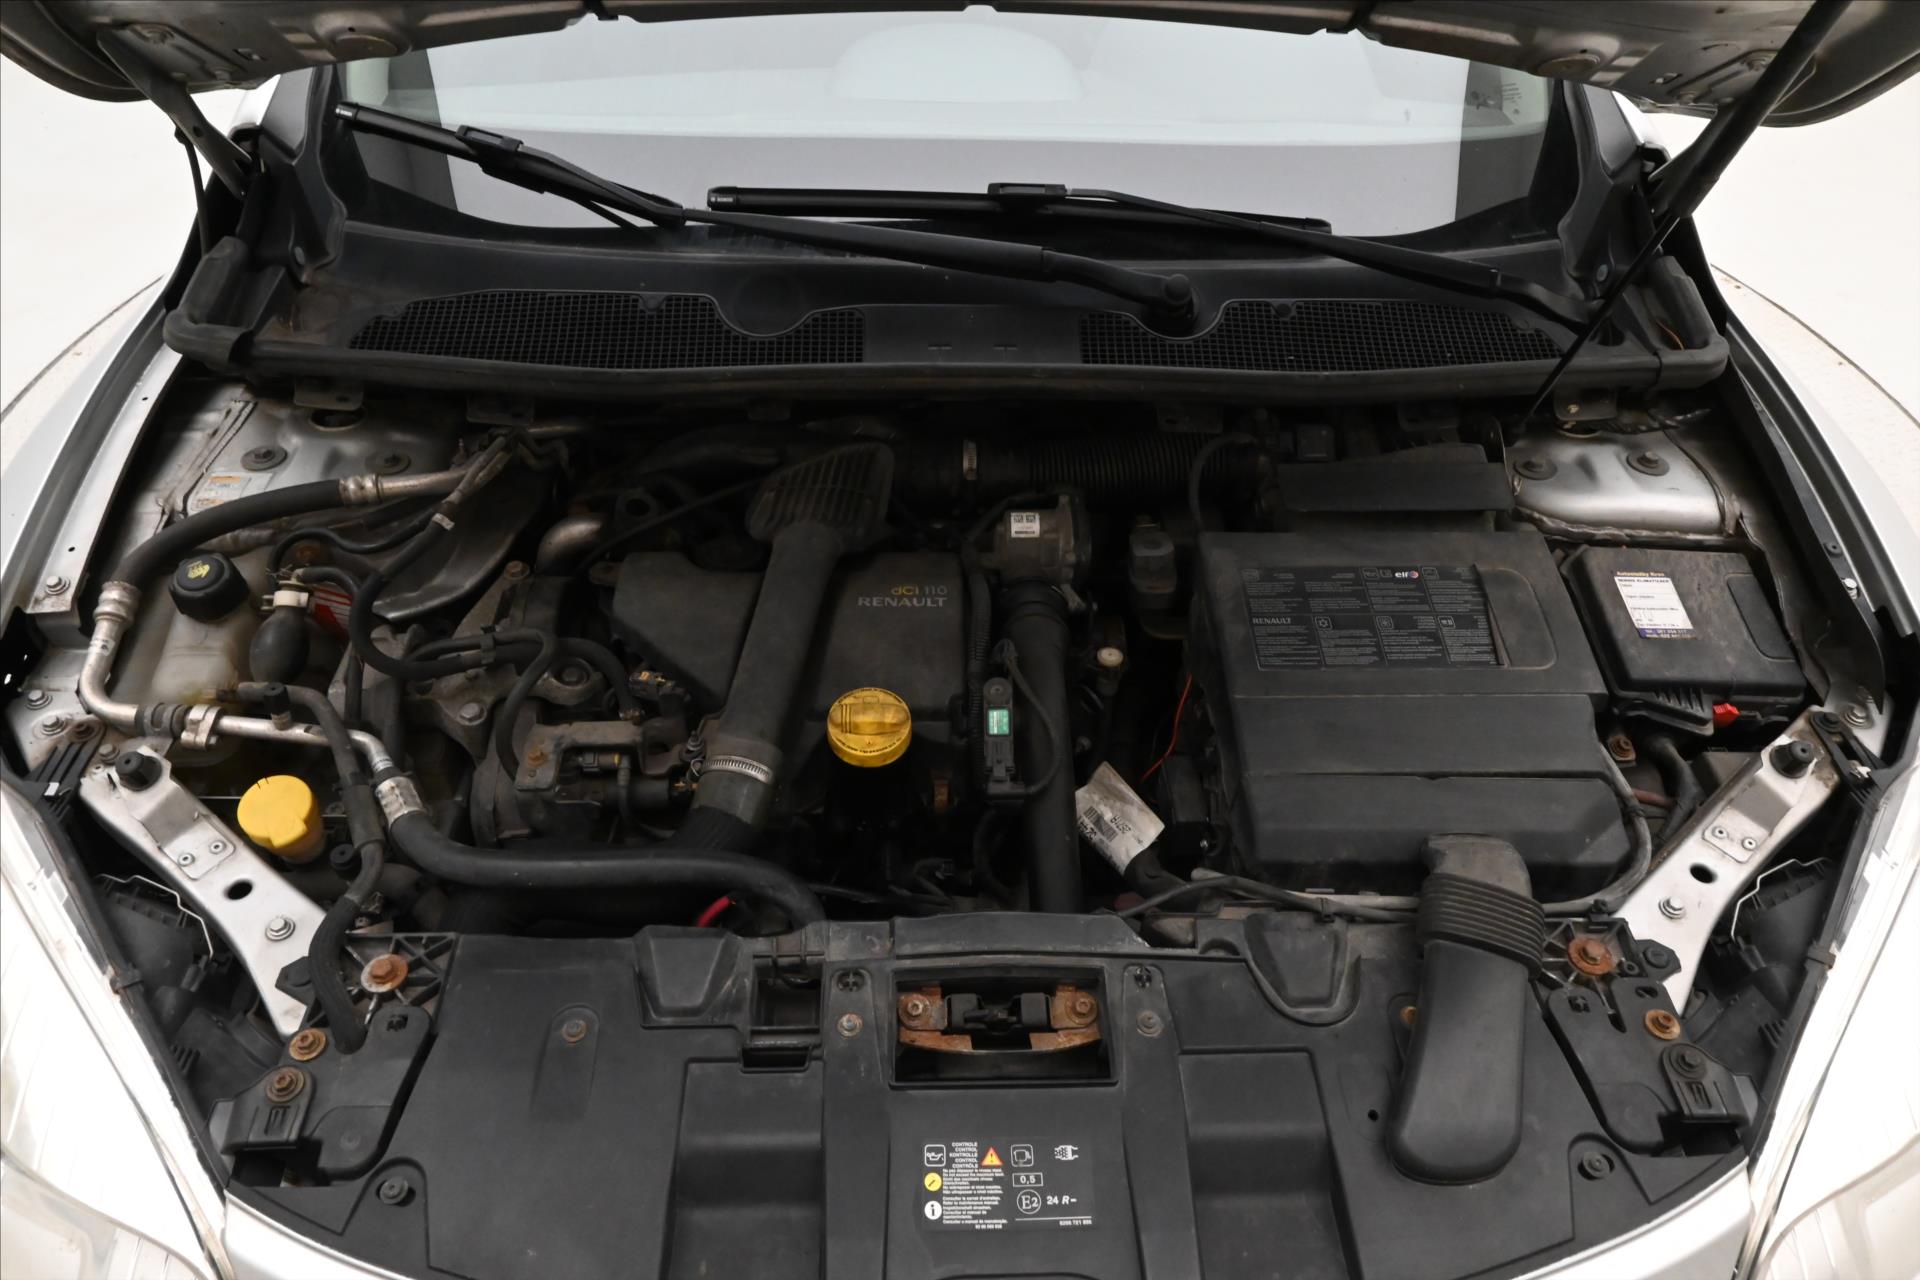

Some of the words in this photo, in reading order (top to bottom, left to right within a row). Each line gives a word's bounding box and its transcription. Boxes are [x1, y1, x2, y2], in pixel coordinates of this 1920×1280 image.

[925, 585, 947, 595] 110
[857, 596, 948, 607] RENAULT
[1252, 617, 1292, 625] RENAULT
[1020, 1175, 1036, 1185] 0,5
[1021, 1195, 1038, 1210] E2
[1046, 1196, 1059, 1205] 24
